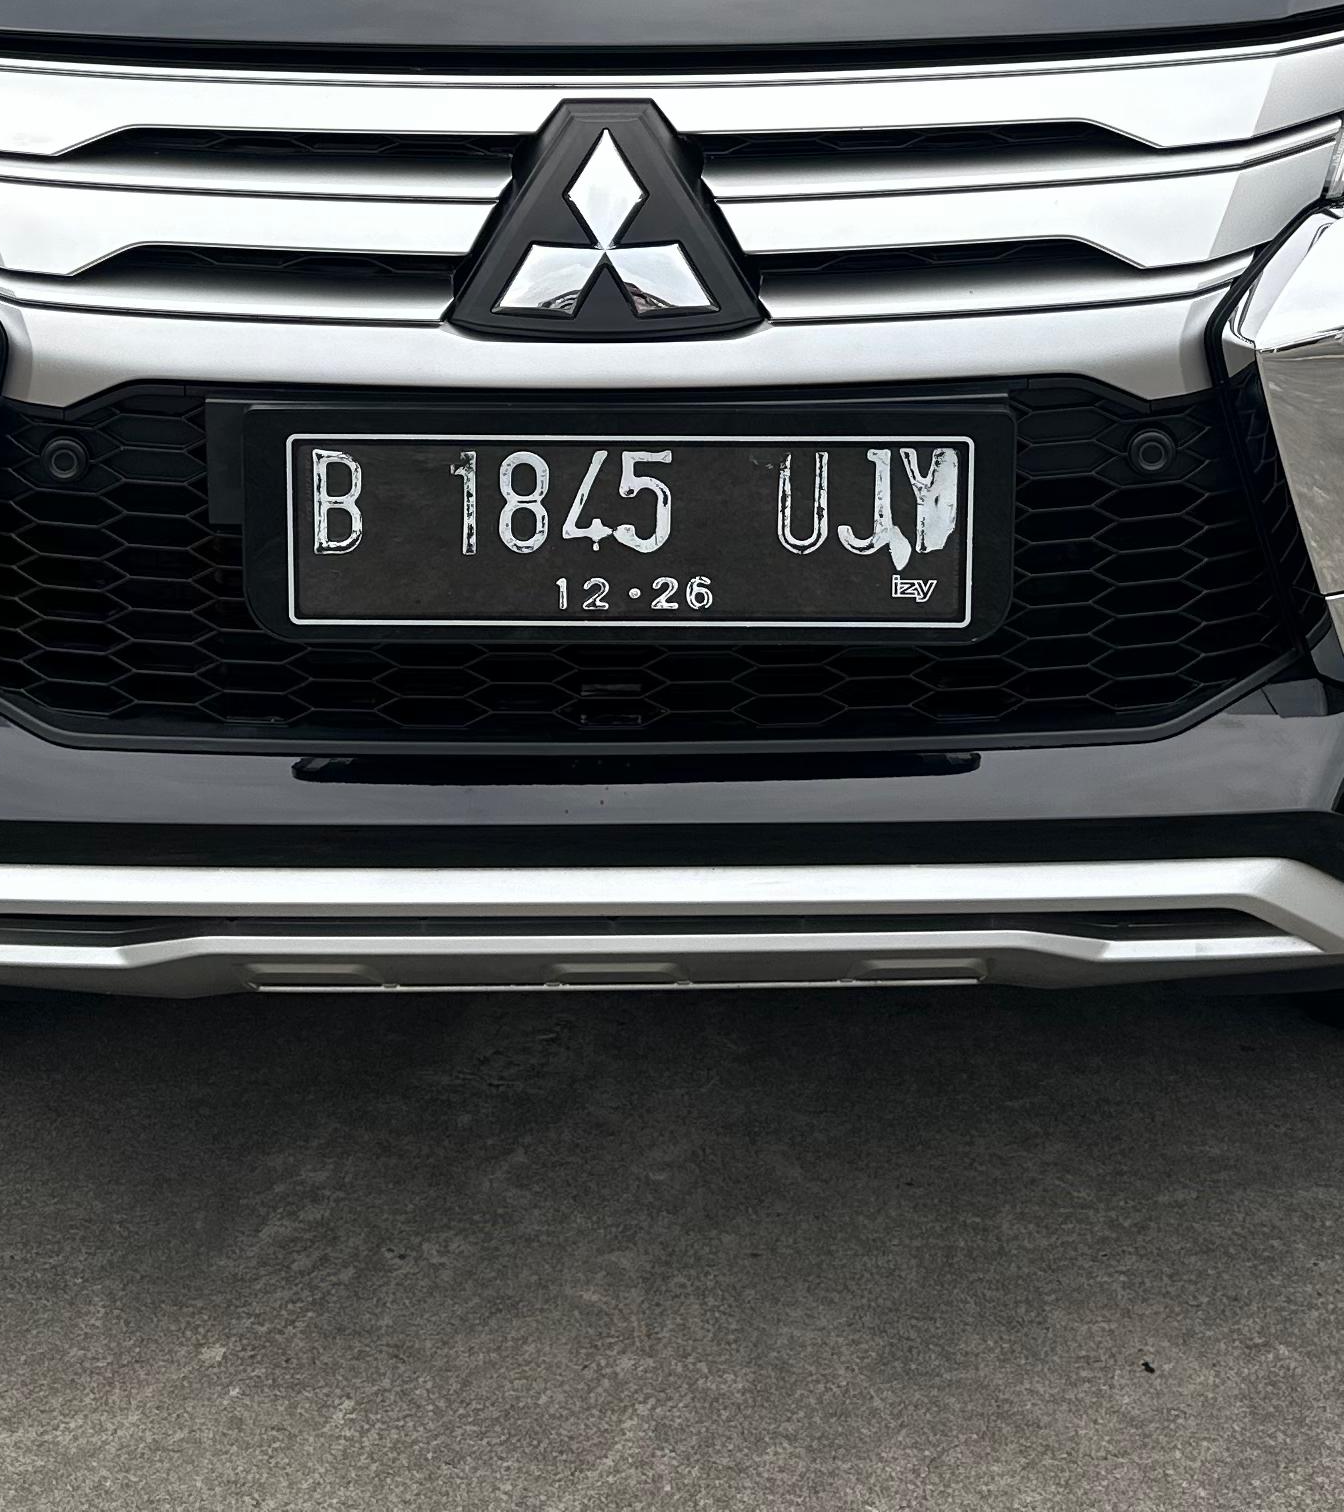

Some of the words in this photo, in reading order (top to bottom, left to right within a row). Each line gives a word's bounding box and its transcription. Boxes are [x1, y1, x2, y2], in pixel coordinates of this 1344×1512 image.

[312, 448, 363, 555] B
[449, 450, 672, 555] 1845
[777, 447, 959, 558] UJY
[891, 574, 937, 603] izy
